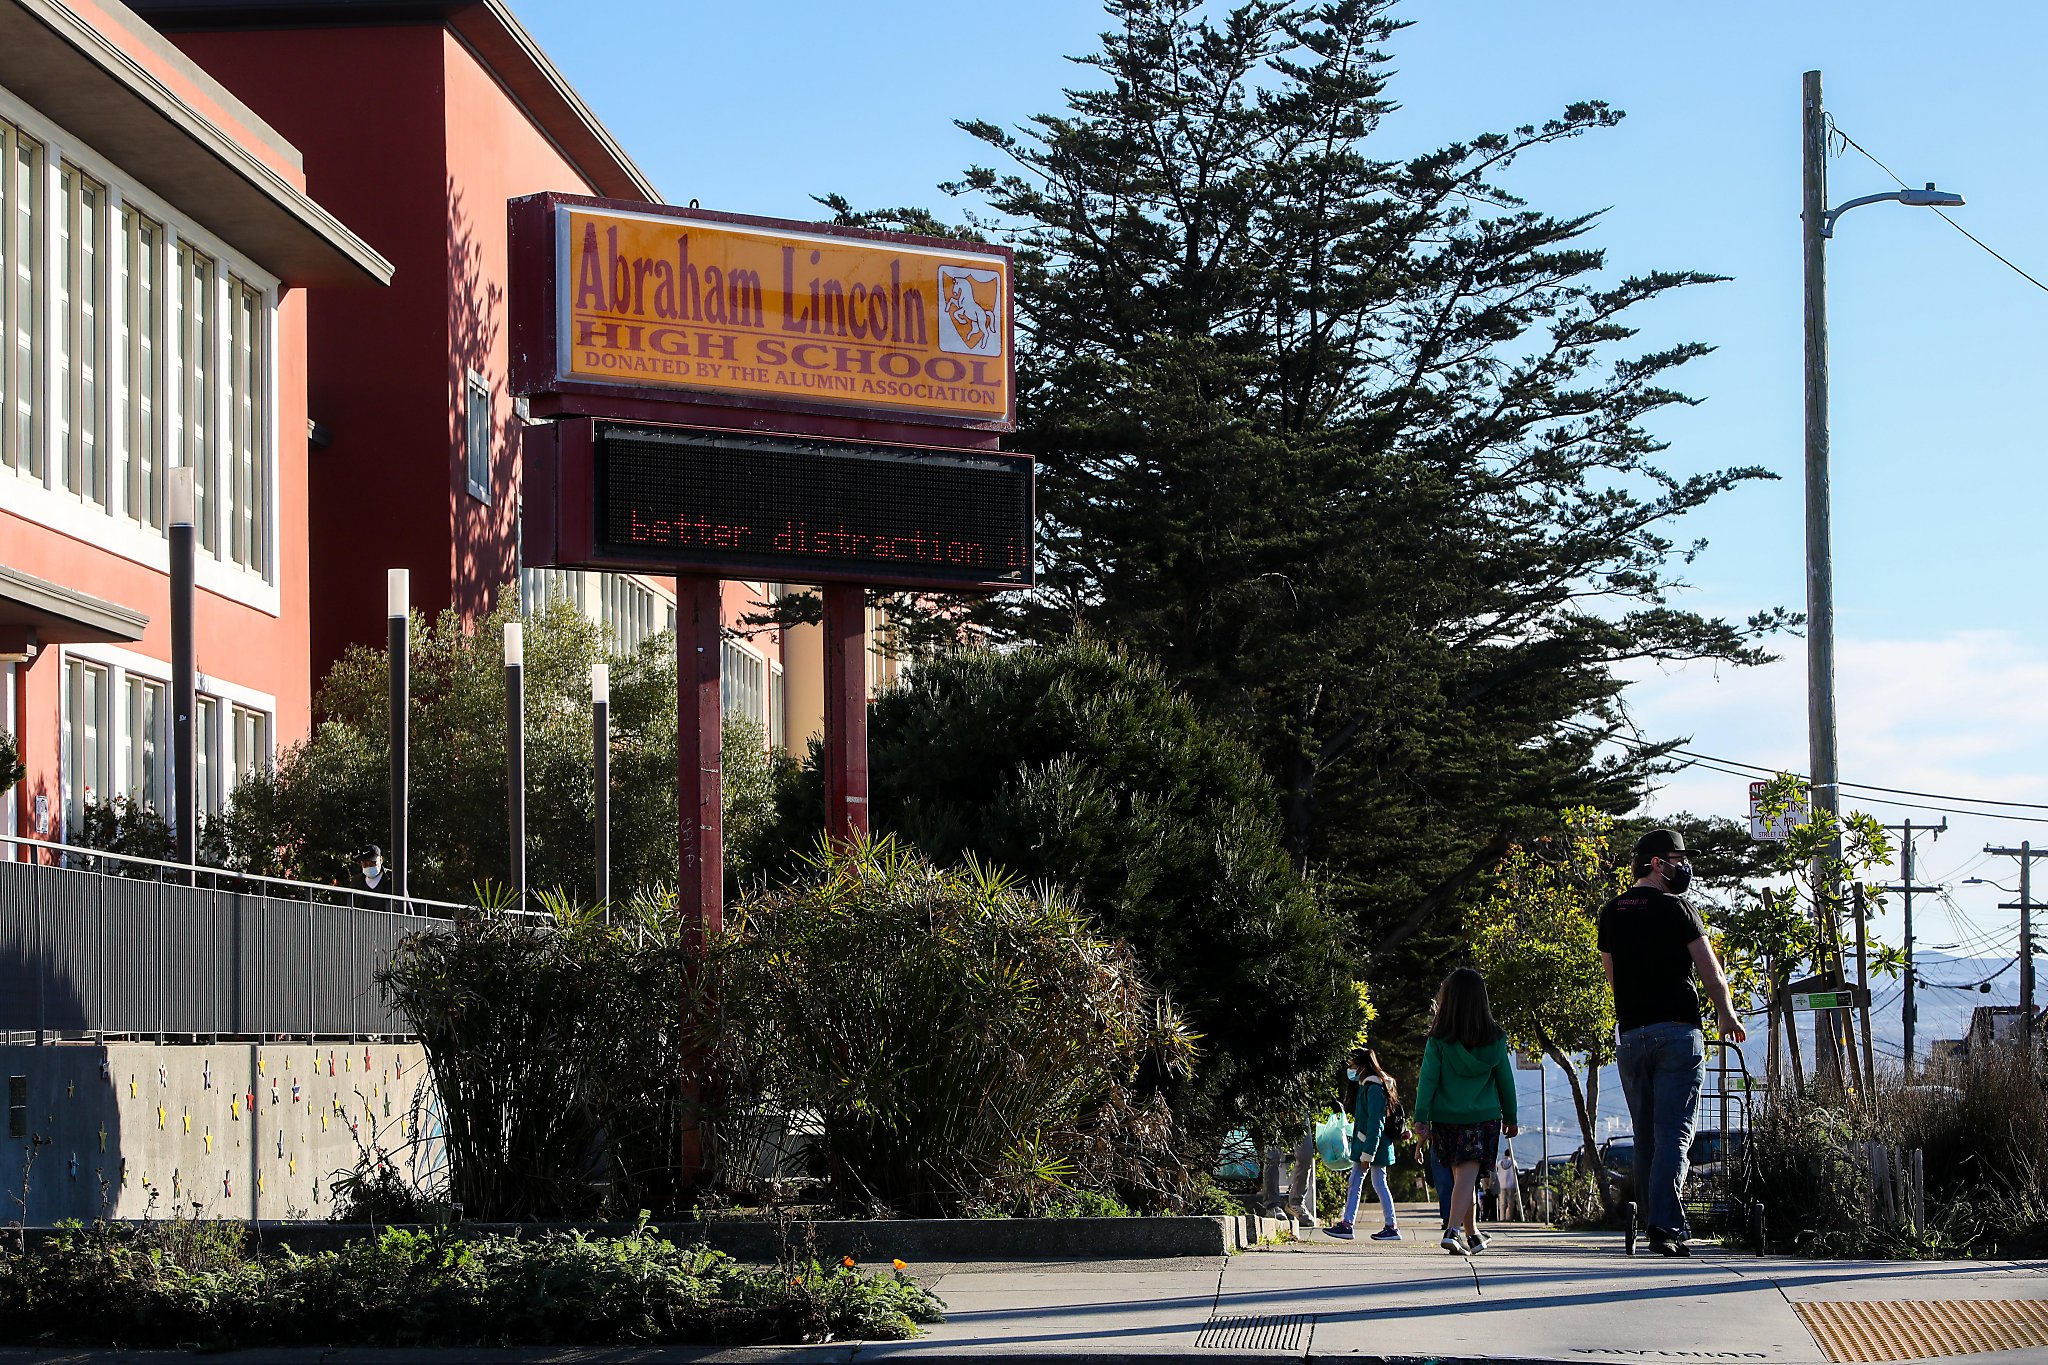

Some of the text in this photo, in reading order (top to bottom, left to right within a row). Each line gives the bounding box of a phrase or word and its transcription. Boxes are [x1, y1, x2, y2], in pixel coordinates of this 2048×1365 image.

[576, 222, 927, 345] Abraham Lincoln
[576, 320, 1002, 387] HIGH SCHOOL
[585, 351, 995, 405] DONATED BY THE ALUMNI ASSOCIATION
[632, 509, 1026, 567] better distraction i
